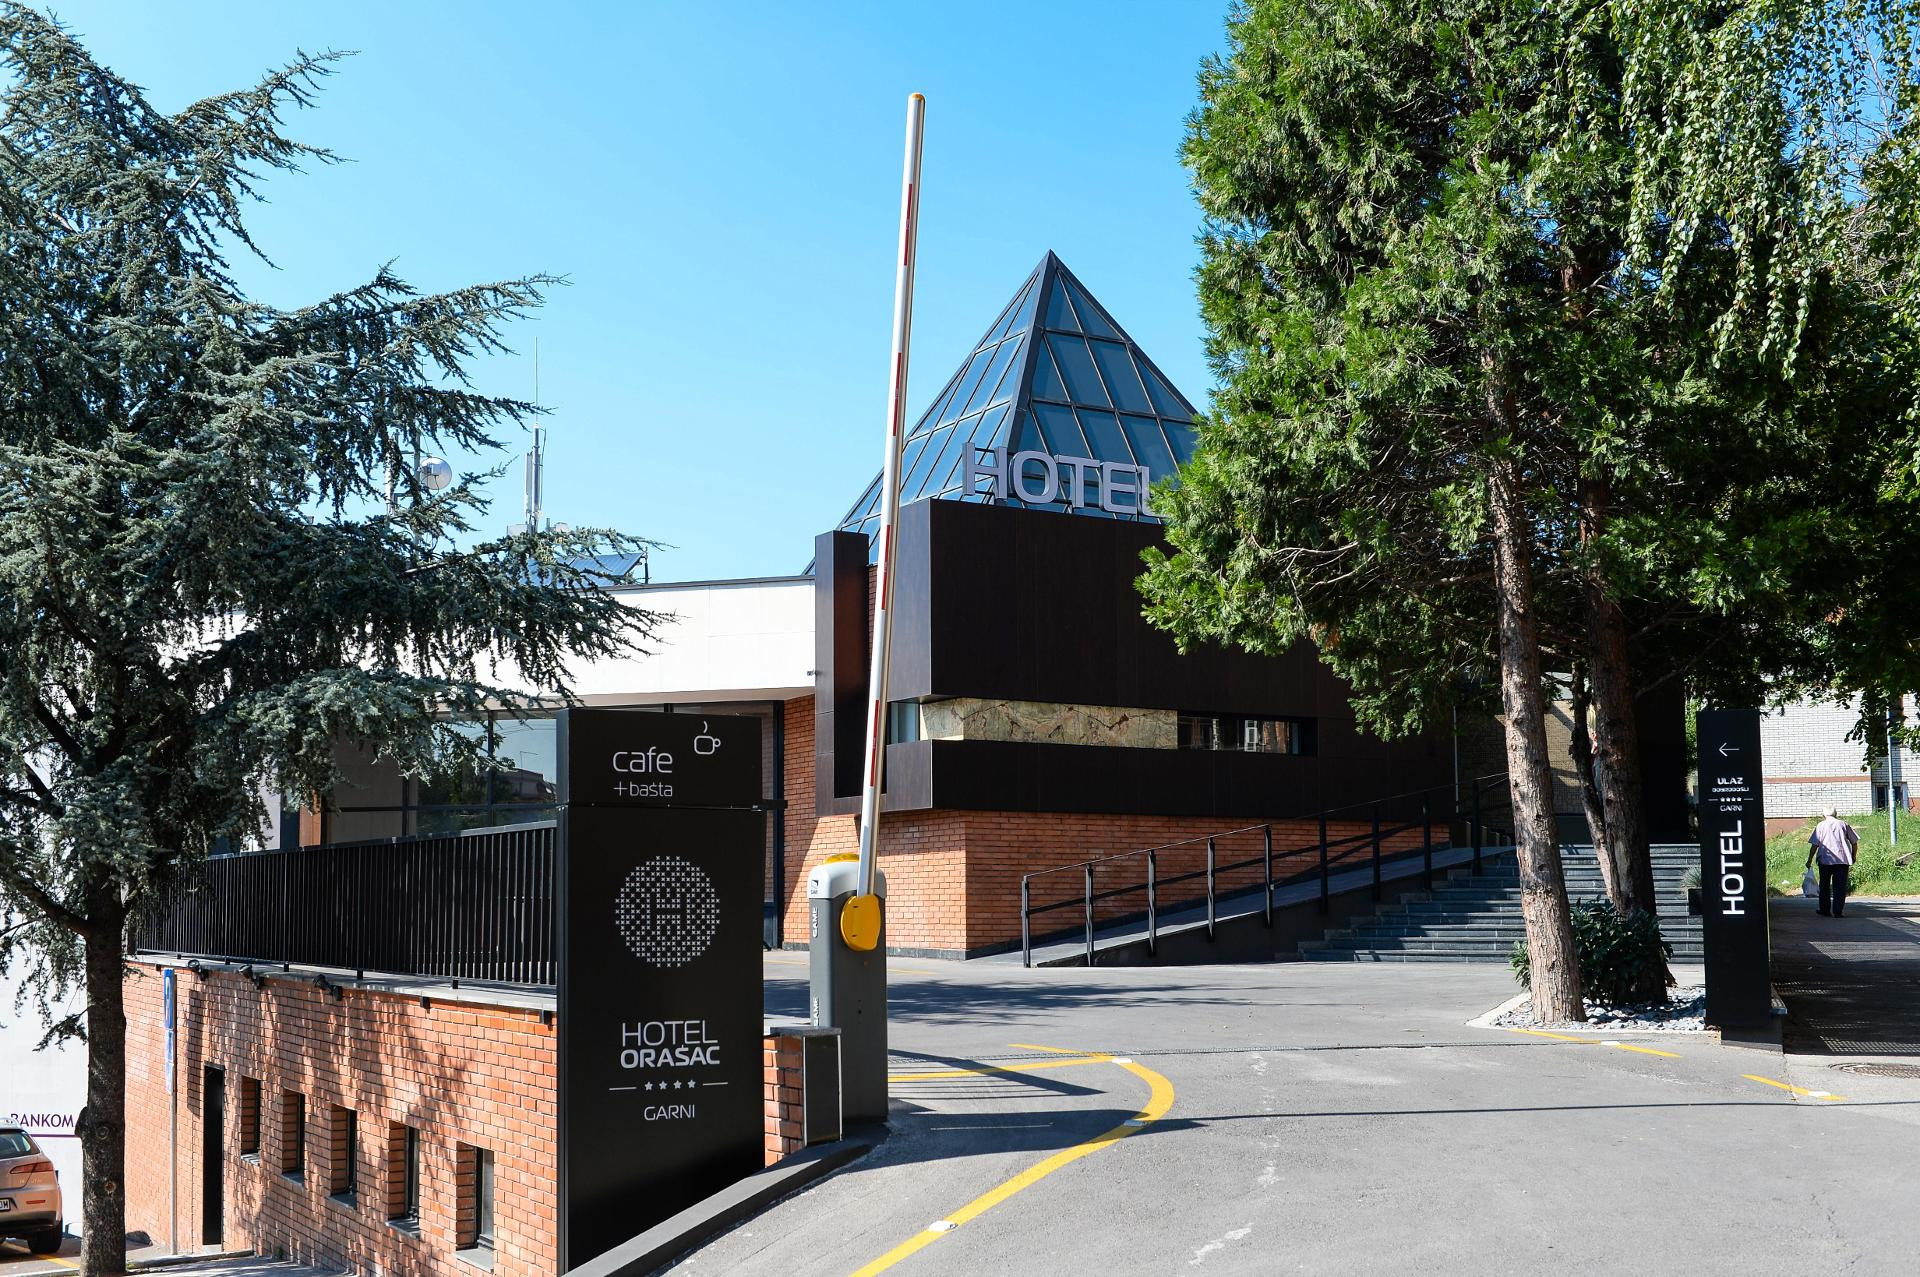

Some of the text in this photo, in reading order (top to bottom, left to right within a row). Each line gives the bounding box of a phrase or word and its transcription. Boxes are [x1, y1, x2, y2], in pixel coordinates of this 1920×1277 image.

[962, 442, 1168, 518] HOTEL
[613, 746, 673, 773] cafe
[1717, 777, 1743, 785] ULAZ
[1720, 804, 1743, 812] GARNI
[1720, 820, 1745, 914] HOTEL
[622, 1020, 718, 1047] HOTEL
[644, 1104, 695, 1121] GARNI
